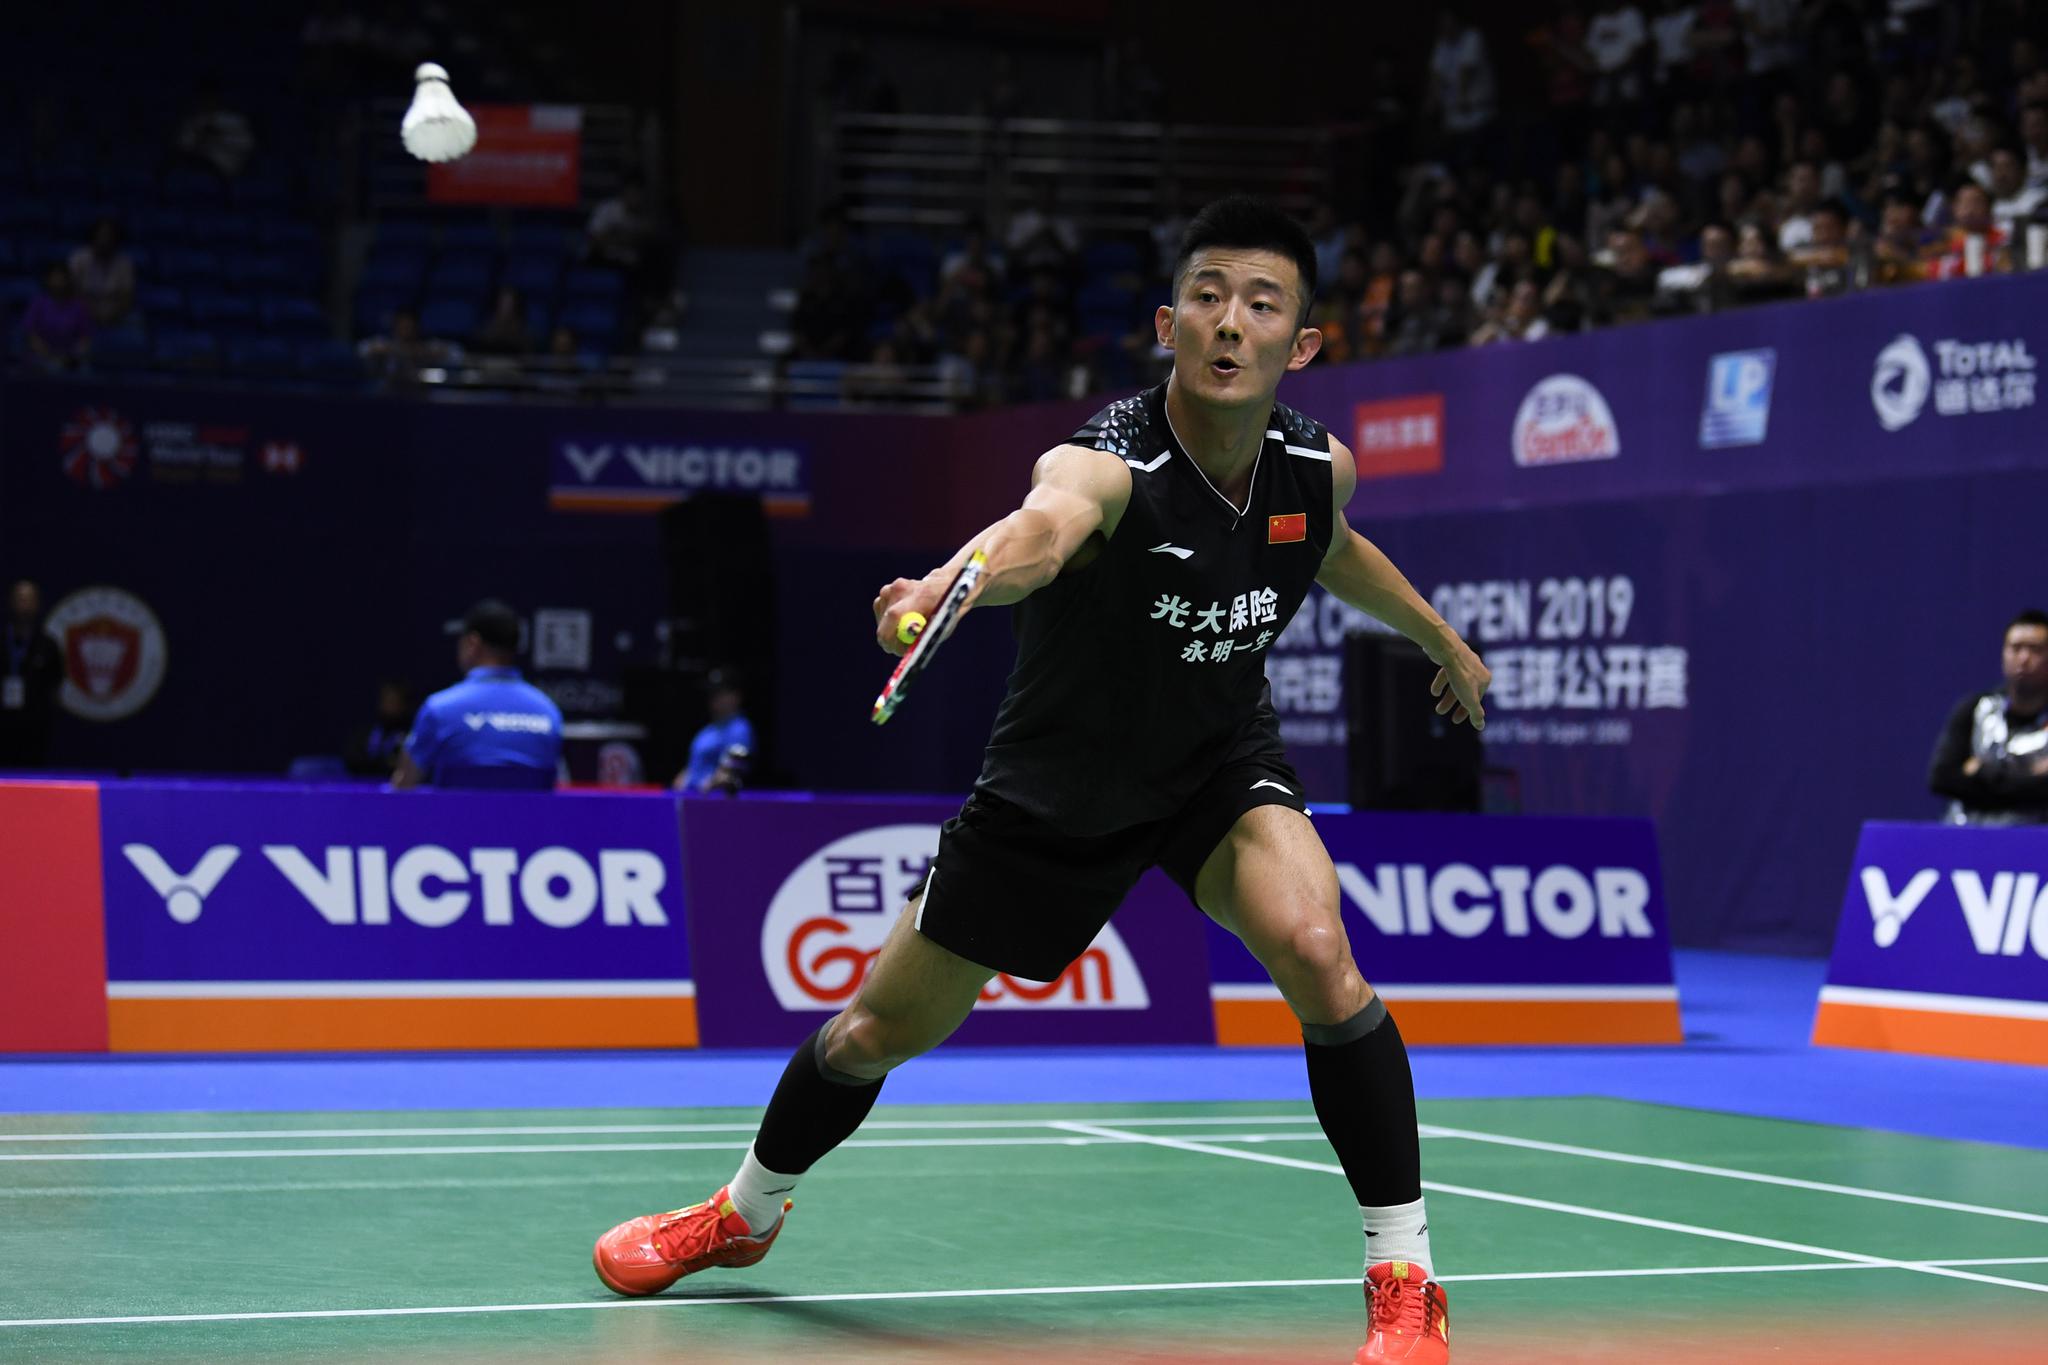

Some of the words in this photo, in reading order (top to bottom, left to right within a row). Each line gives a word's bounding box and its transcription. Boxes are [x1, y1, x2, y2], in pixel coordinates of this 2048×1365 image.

[1933, 338, 2037, 377] TOTAL
[622, 443, 801, 489] VICTOR
[1149, 586, 1279, 634] 光大保险
[1535, 573, 1635, 640] 2019
[1180, 628, 1275, 663] 永明一生
[262, 844, 669, 928] VICTOR
[1334, 863, 1656, 939] VICTOR
